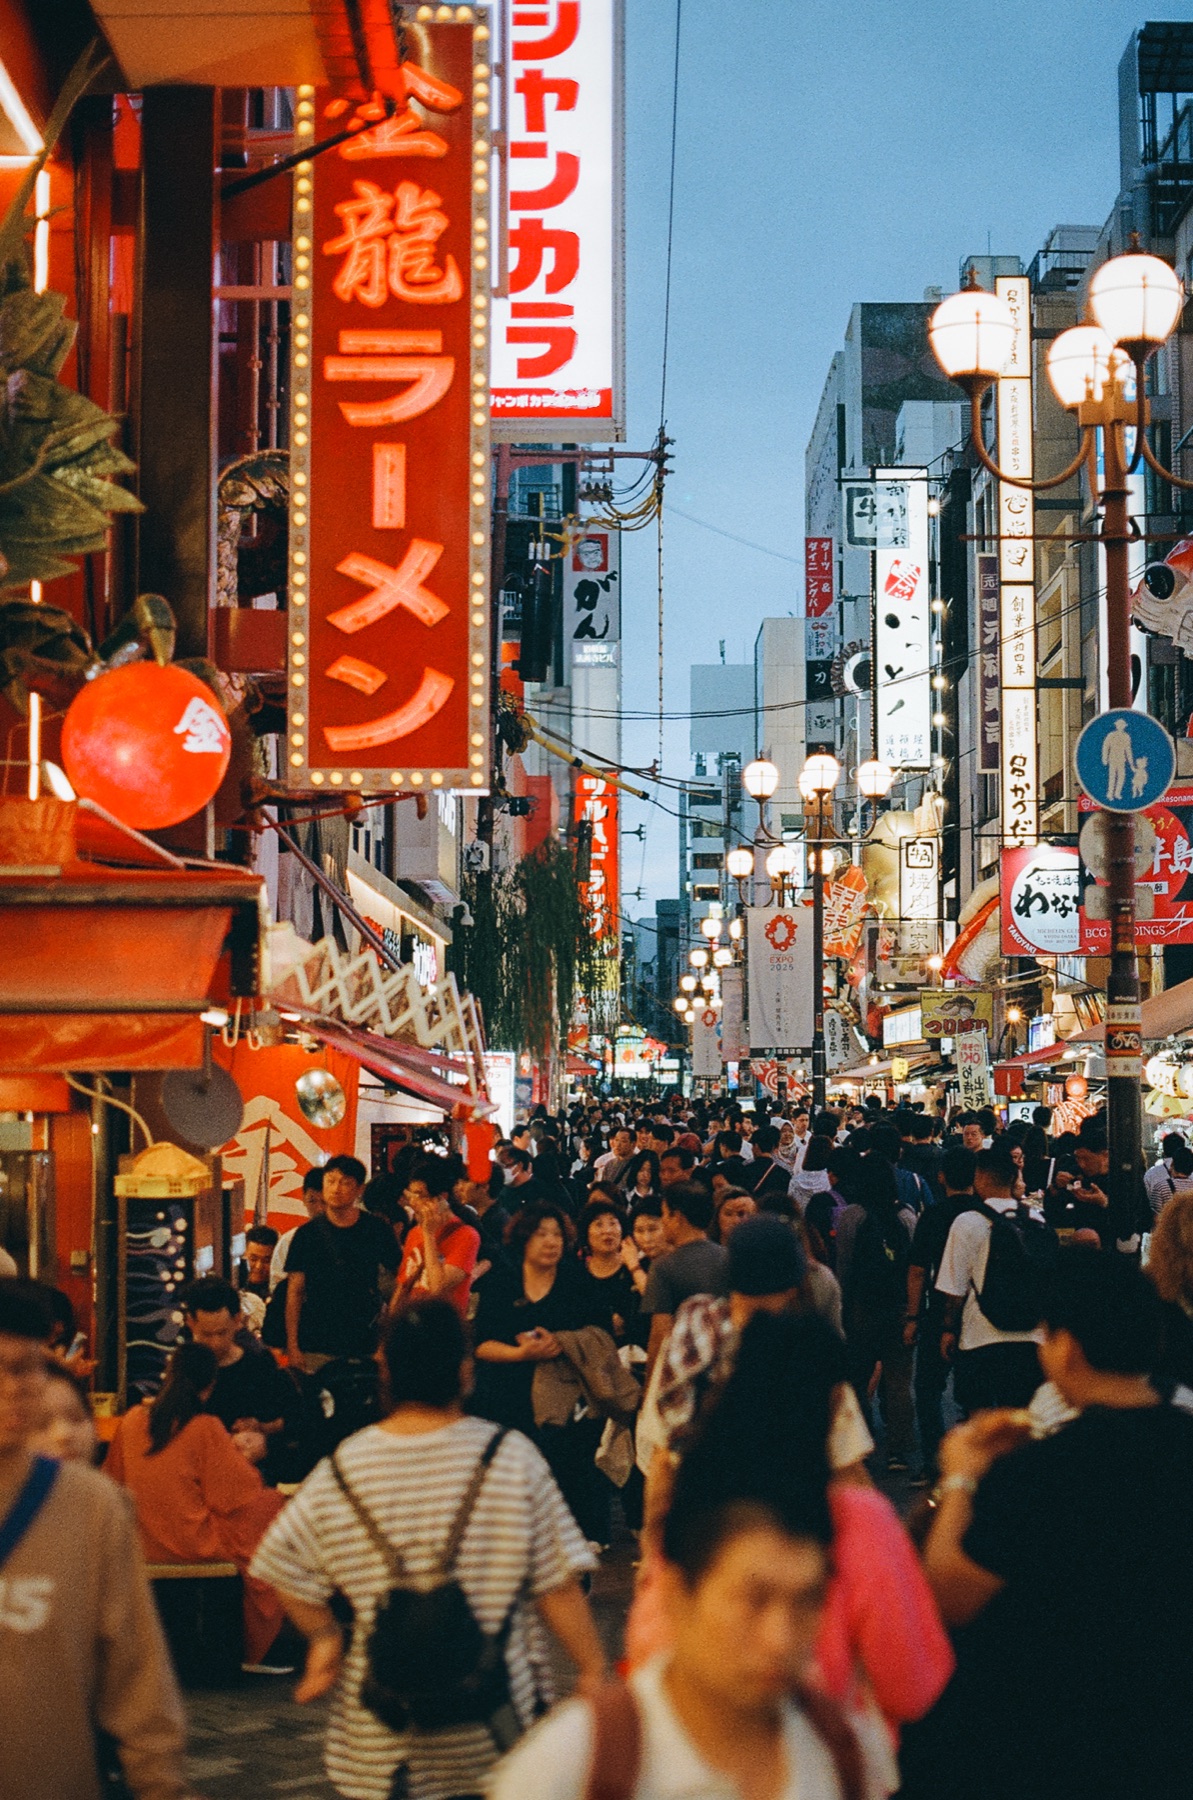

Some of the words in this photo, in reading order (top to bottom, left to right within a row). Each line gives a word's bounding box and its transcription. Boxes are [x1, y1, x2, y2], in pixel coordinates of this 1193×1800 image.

[321, 61, 463, 753] 金龍ラーメン
[808, 541, 818, 617] ダイニングバー
[820, 541, 831, 571] ダーツ
[822, 583, 831, 593] &
[1011, 595, 1025, 676] 創業昭和四年
[174, 696, 231, 754] 金
[909, 872, 930, 950] 焼肉酒家
[1014, 884, 1079, 918] わな
[1007, 923, 1038, 954] TAKOYAKI
[1085, 927, 1107, 938] BCG
